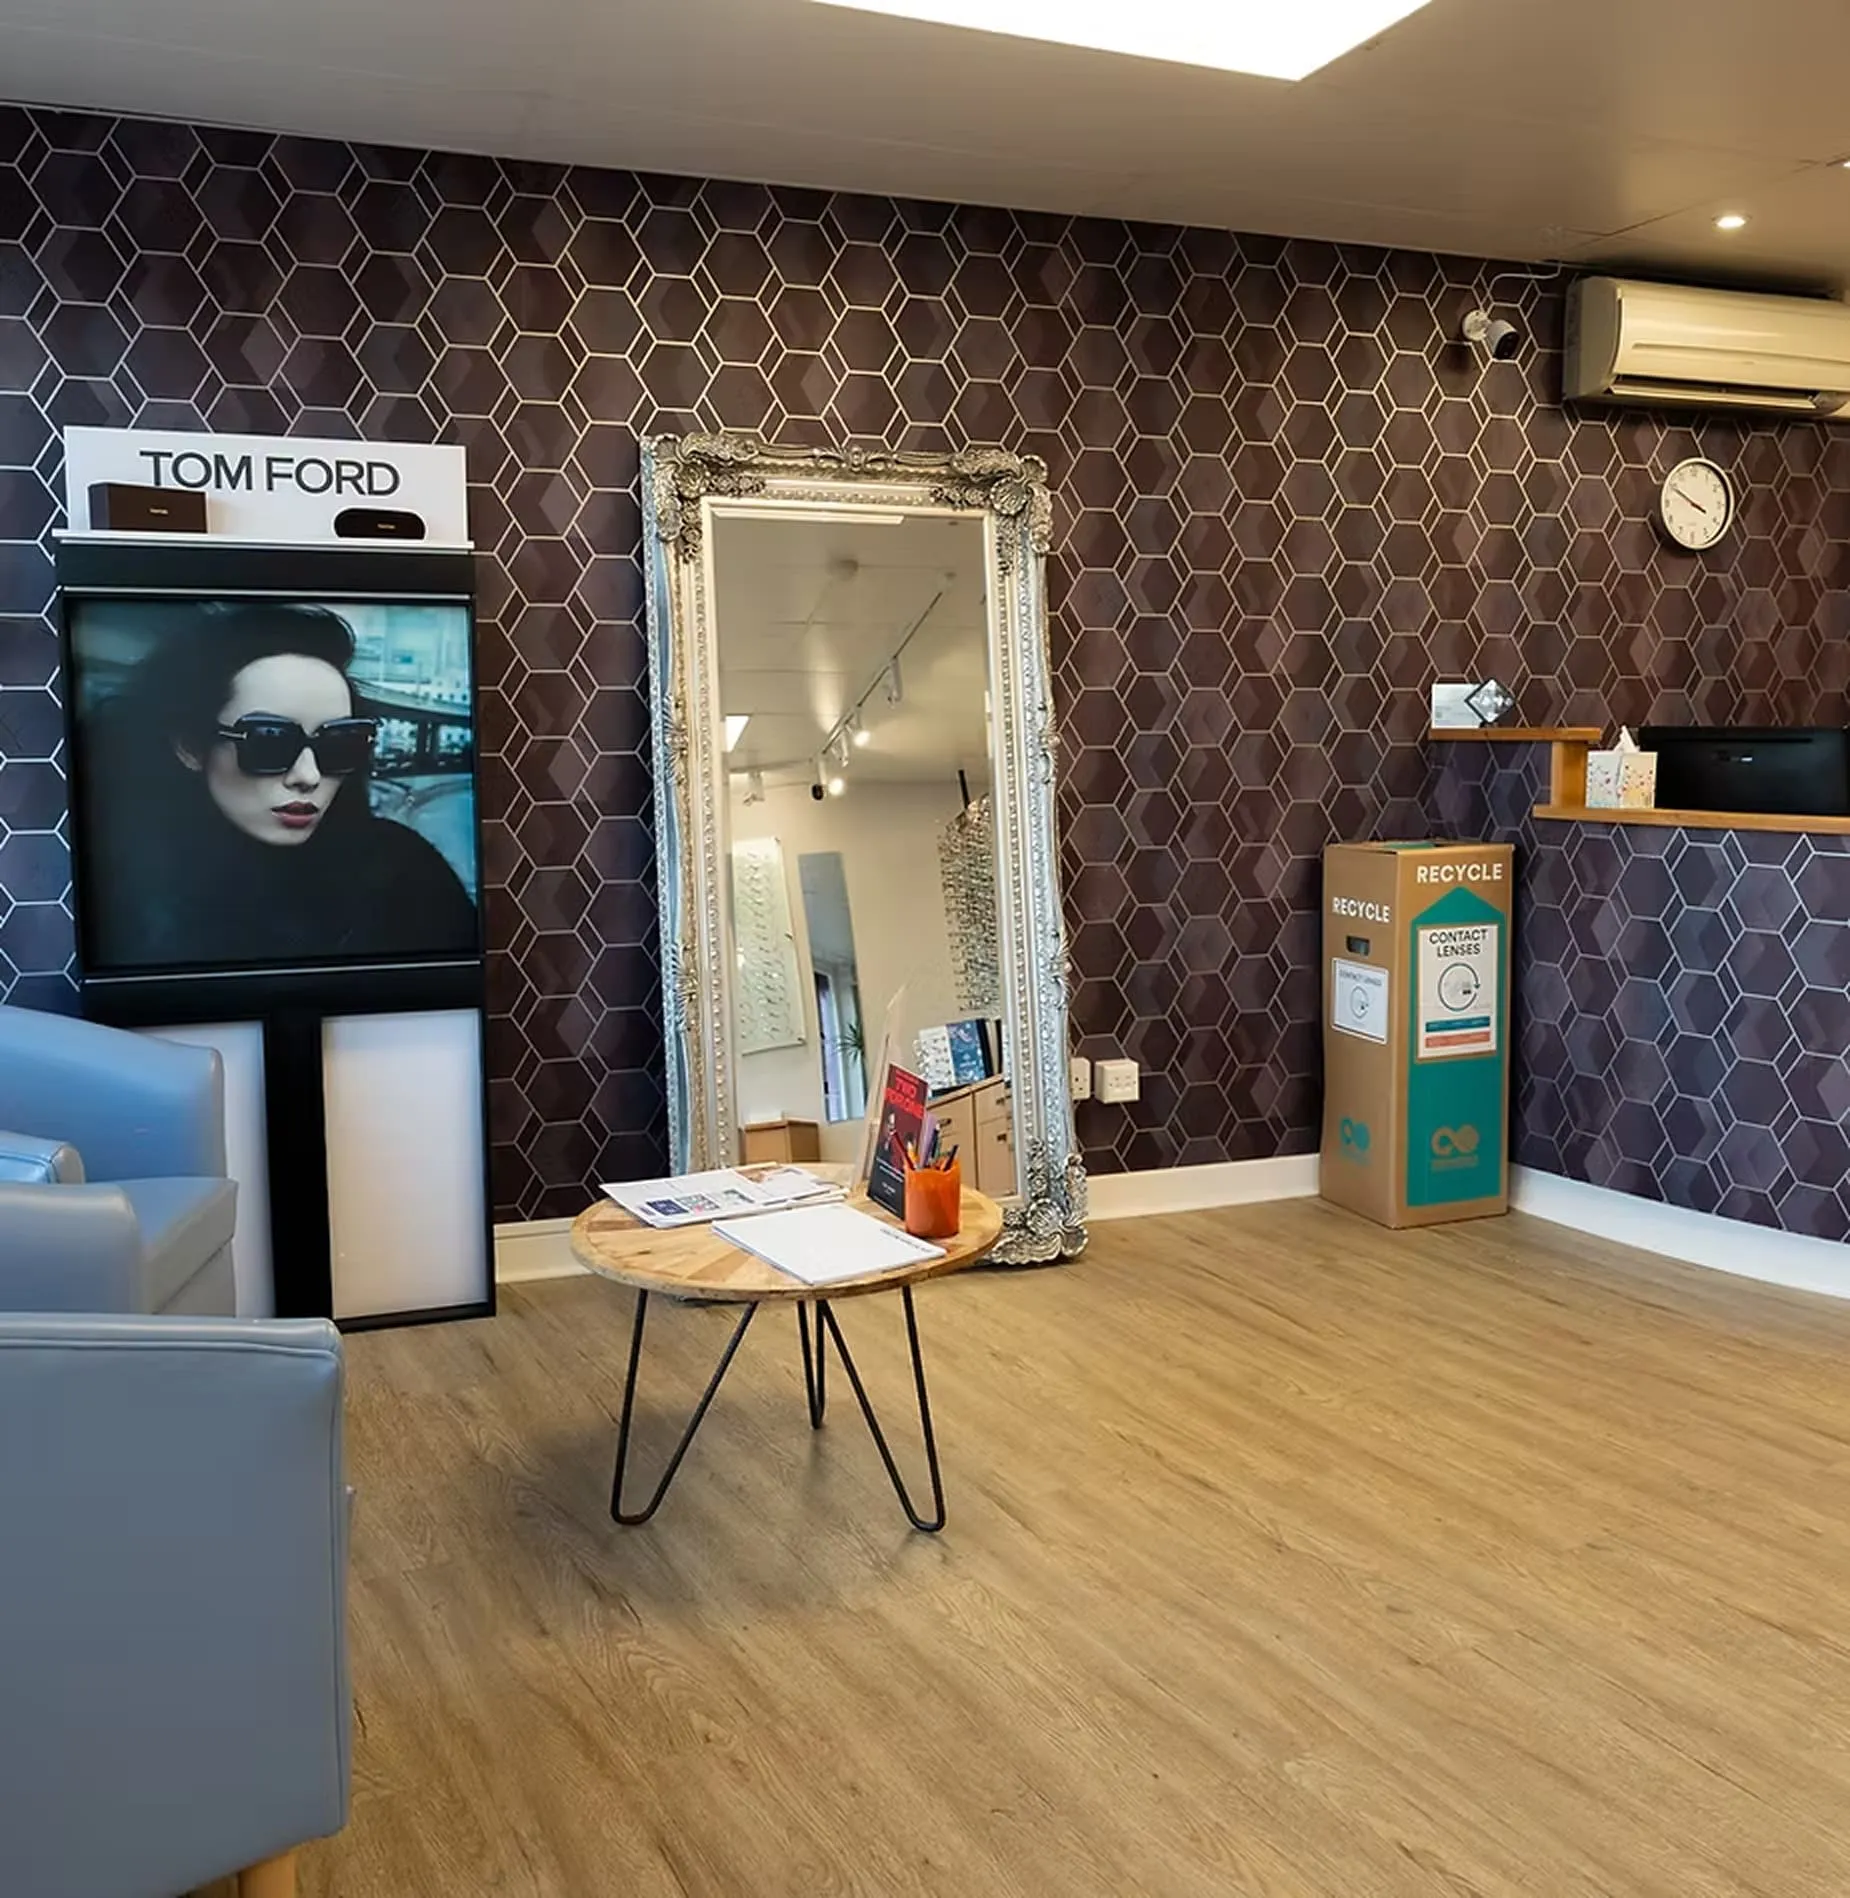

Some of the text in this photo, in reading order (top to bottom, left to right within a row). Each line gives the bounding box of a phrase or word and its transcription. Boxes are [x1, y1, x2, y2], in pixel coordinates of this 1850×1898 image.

[139, 450, 401, 497] TOM FORD
[1416, 863, 1503, 884] RECYCLE
[1332, 897, 1391, 924] RECYCLE
[1429, 929, 1488, 945] CONTACT
[1437, 943, 1481, 958] LENSES
